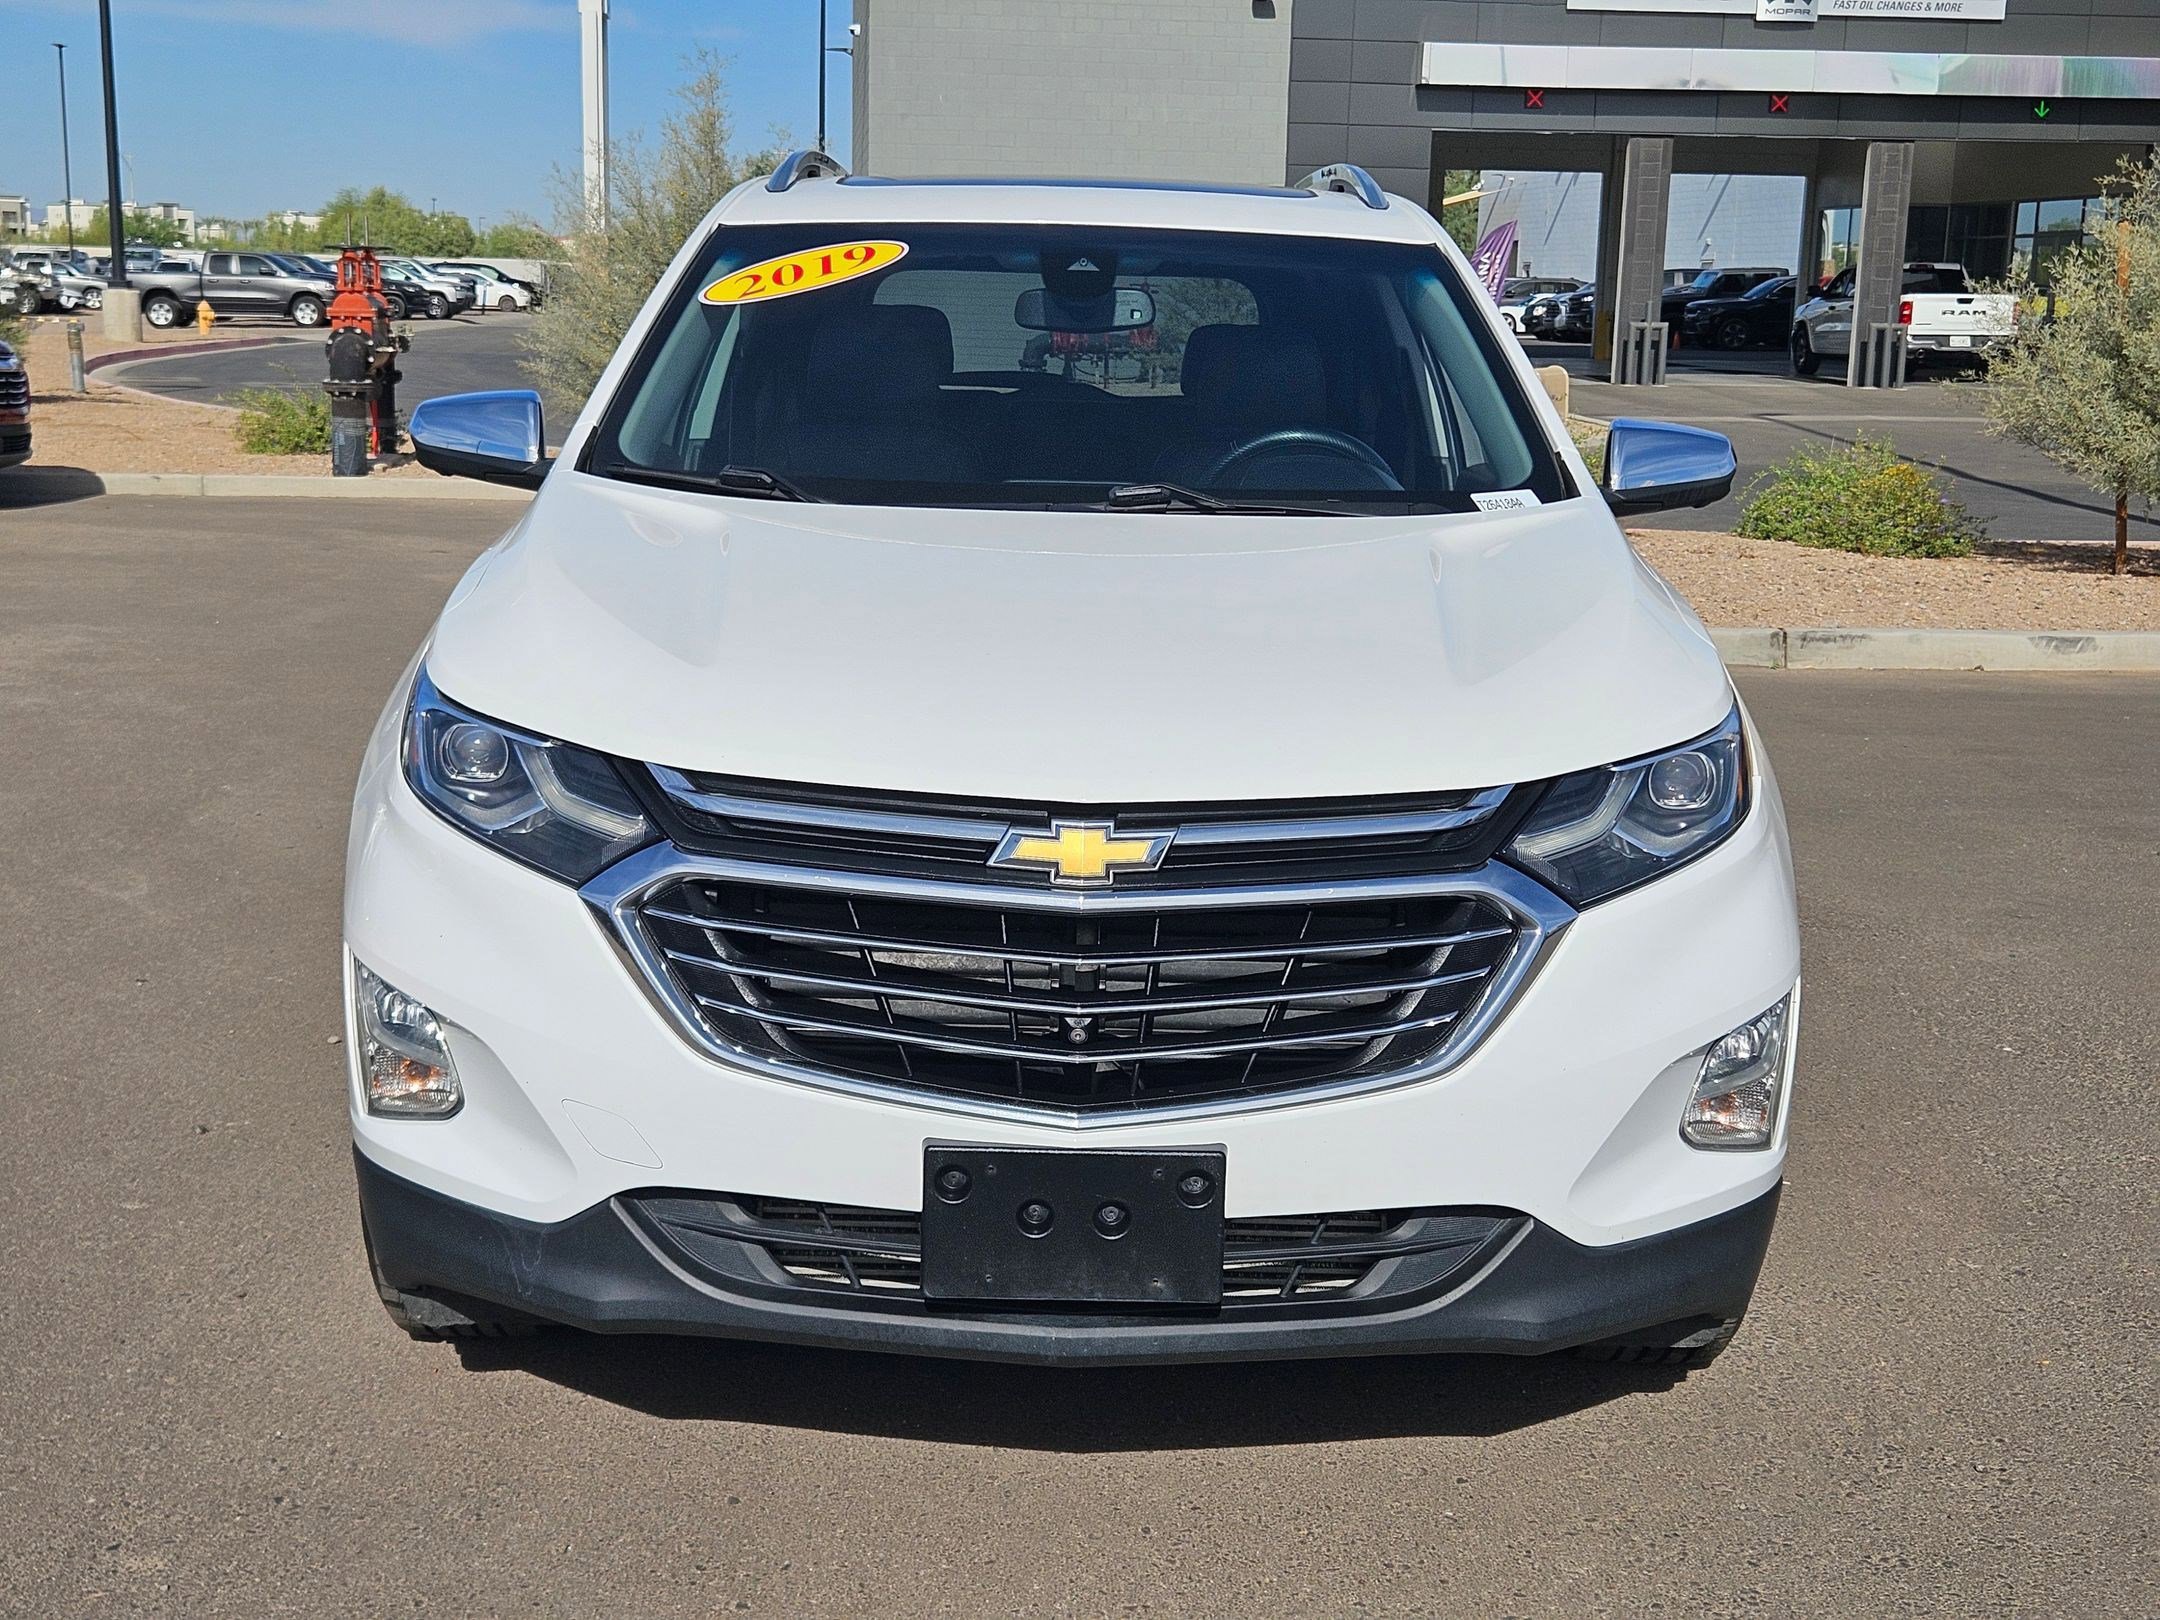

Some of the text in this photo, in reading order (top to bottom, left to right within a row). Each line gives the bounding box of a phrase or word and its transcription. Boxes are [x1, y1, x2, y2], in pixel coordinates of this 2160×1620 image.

[1833, 0, 1964, 12] FAST OIL CHANGES & MORE
[734, 246, 876, 299] 2019
